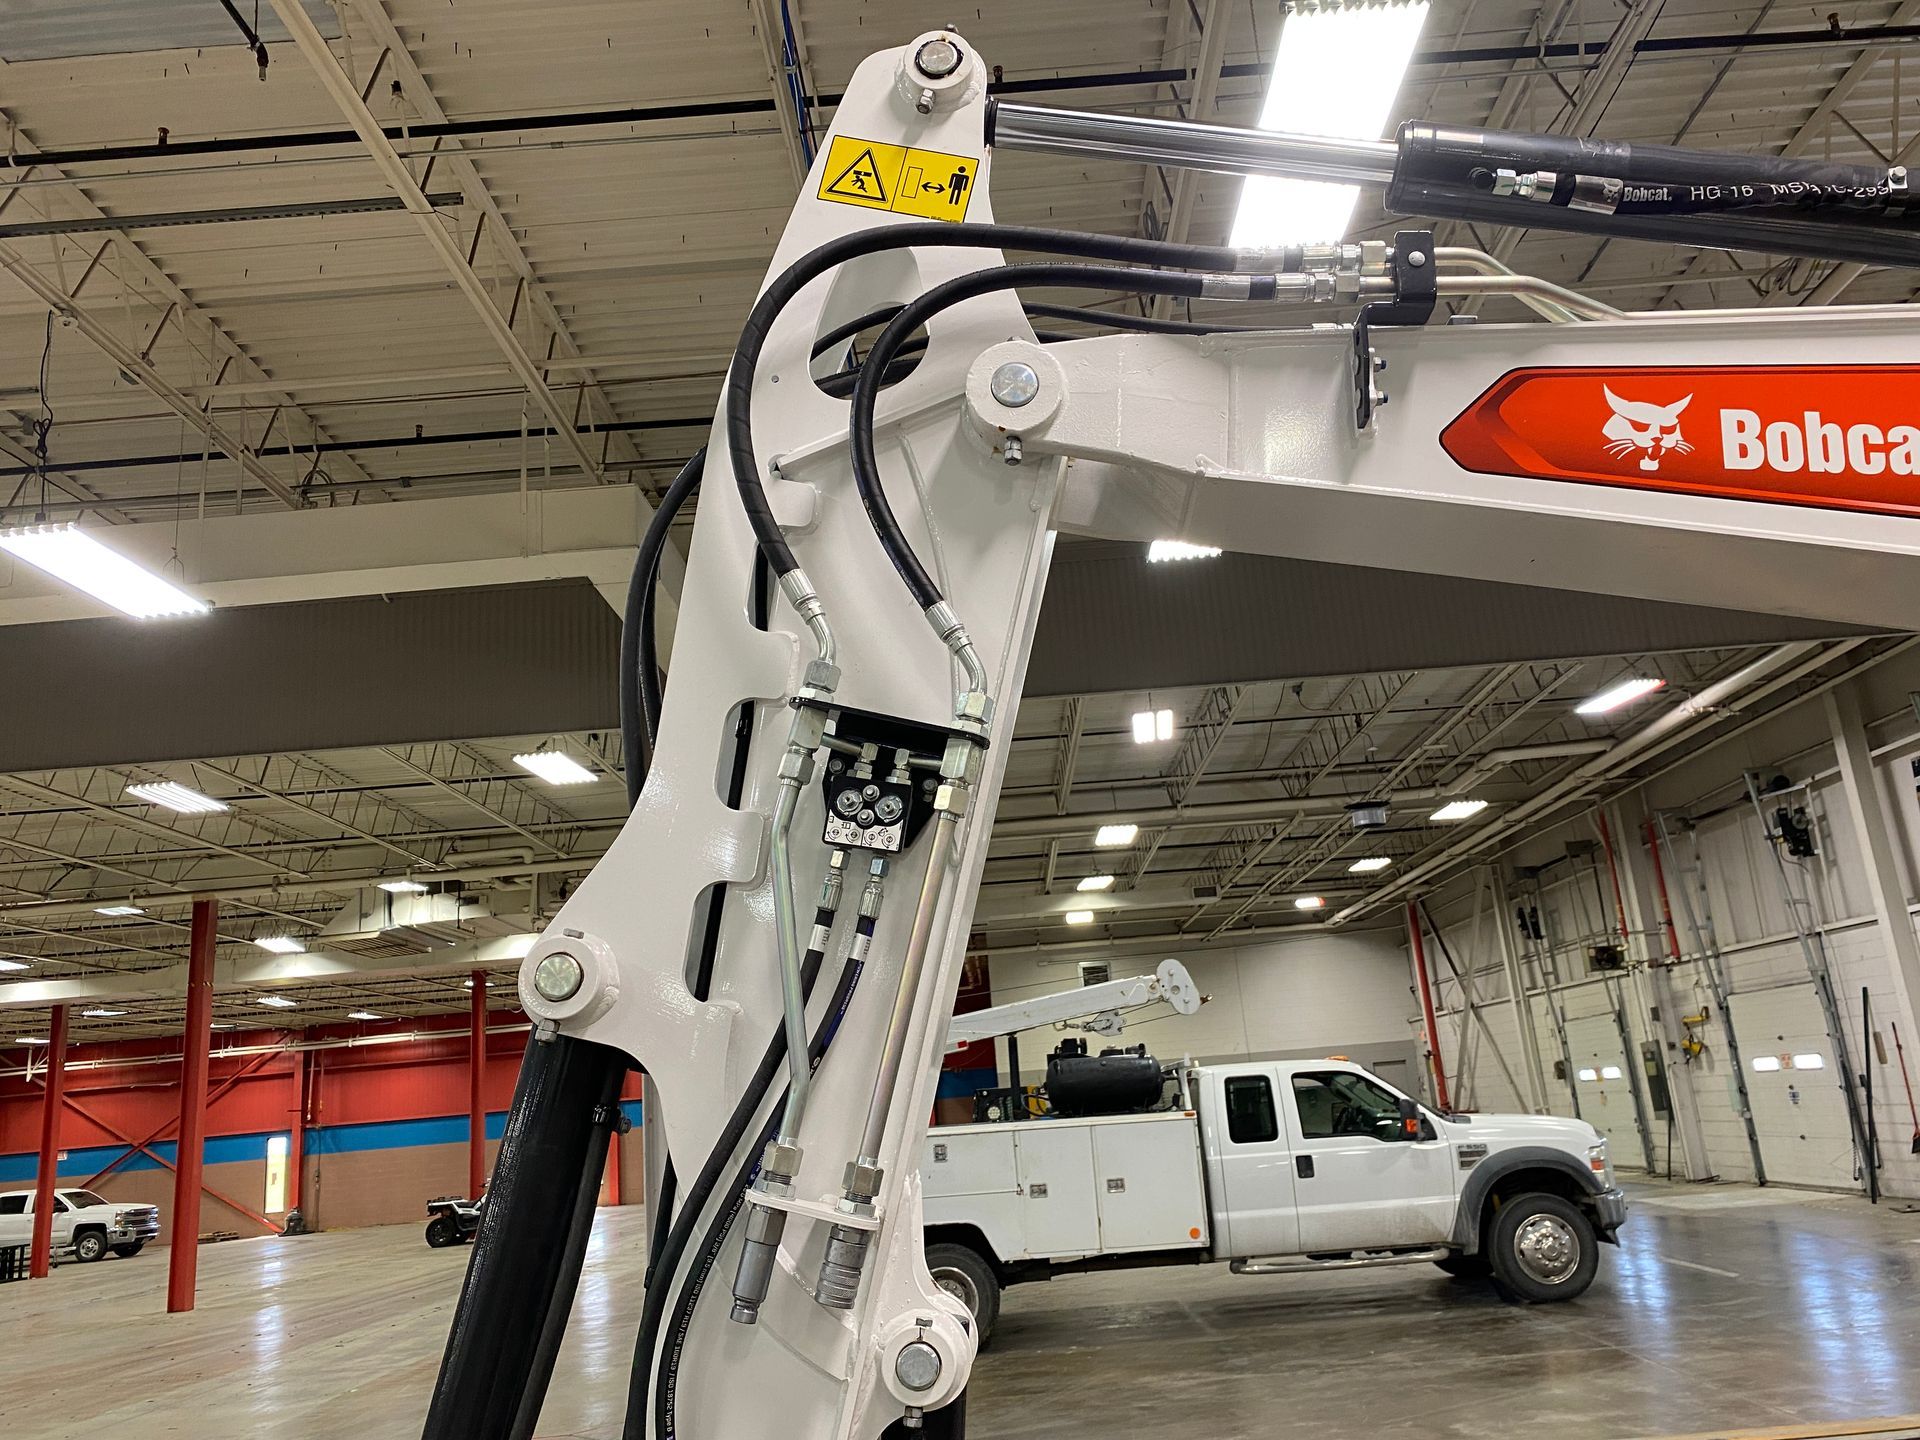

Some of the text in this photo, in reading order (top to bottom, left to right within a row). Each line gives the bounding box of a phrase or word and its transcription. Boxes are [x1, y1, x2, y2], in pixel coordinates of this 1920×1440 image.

[1690, 185, 1754, 200] HG-16
[1720, 408, 1920, 475] Bobca
[665, 1410, 673, 1426] Type
